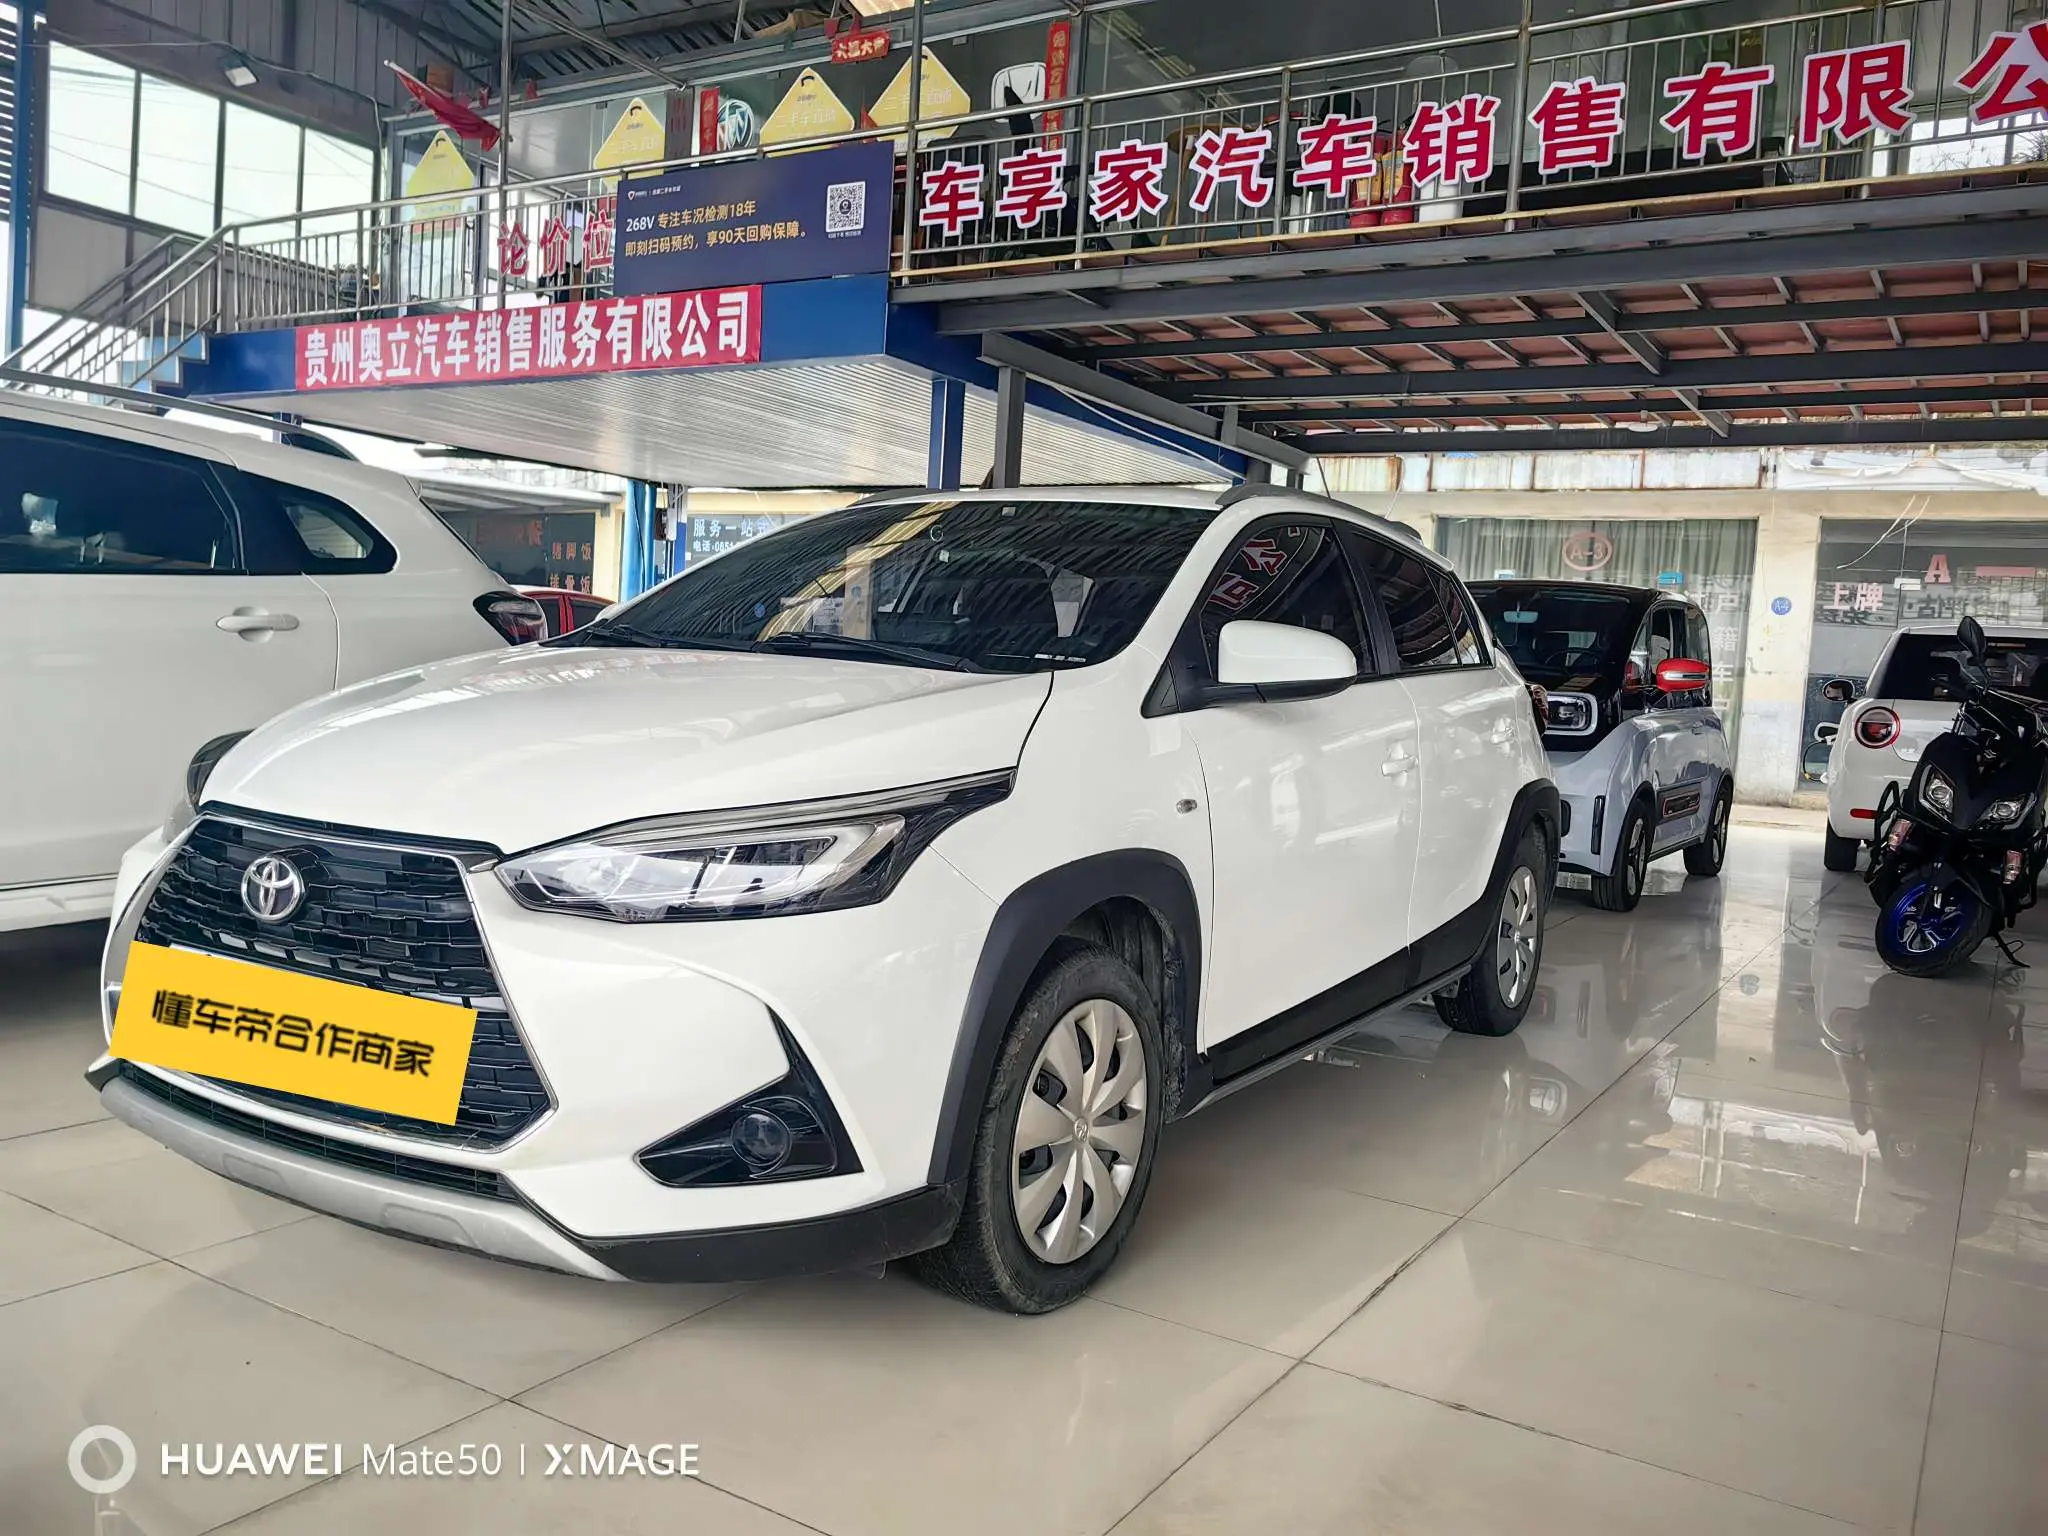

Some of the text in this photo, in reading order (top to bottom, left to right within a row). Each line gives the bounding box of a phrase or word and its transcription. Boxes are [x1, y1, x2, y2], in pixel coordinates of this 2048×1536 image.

[626, 200, 756, 233] 268V 专注车况检测18年
[305, 291, 749, 387] 贵州奥立汽车销售服务有限公司
[1823, 582, 1884, 612] 上牌
